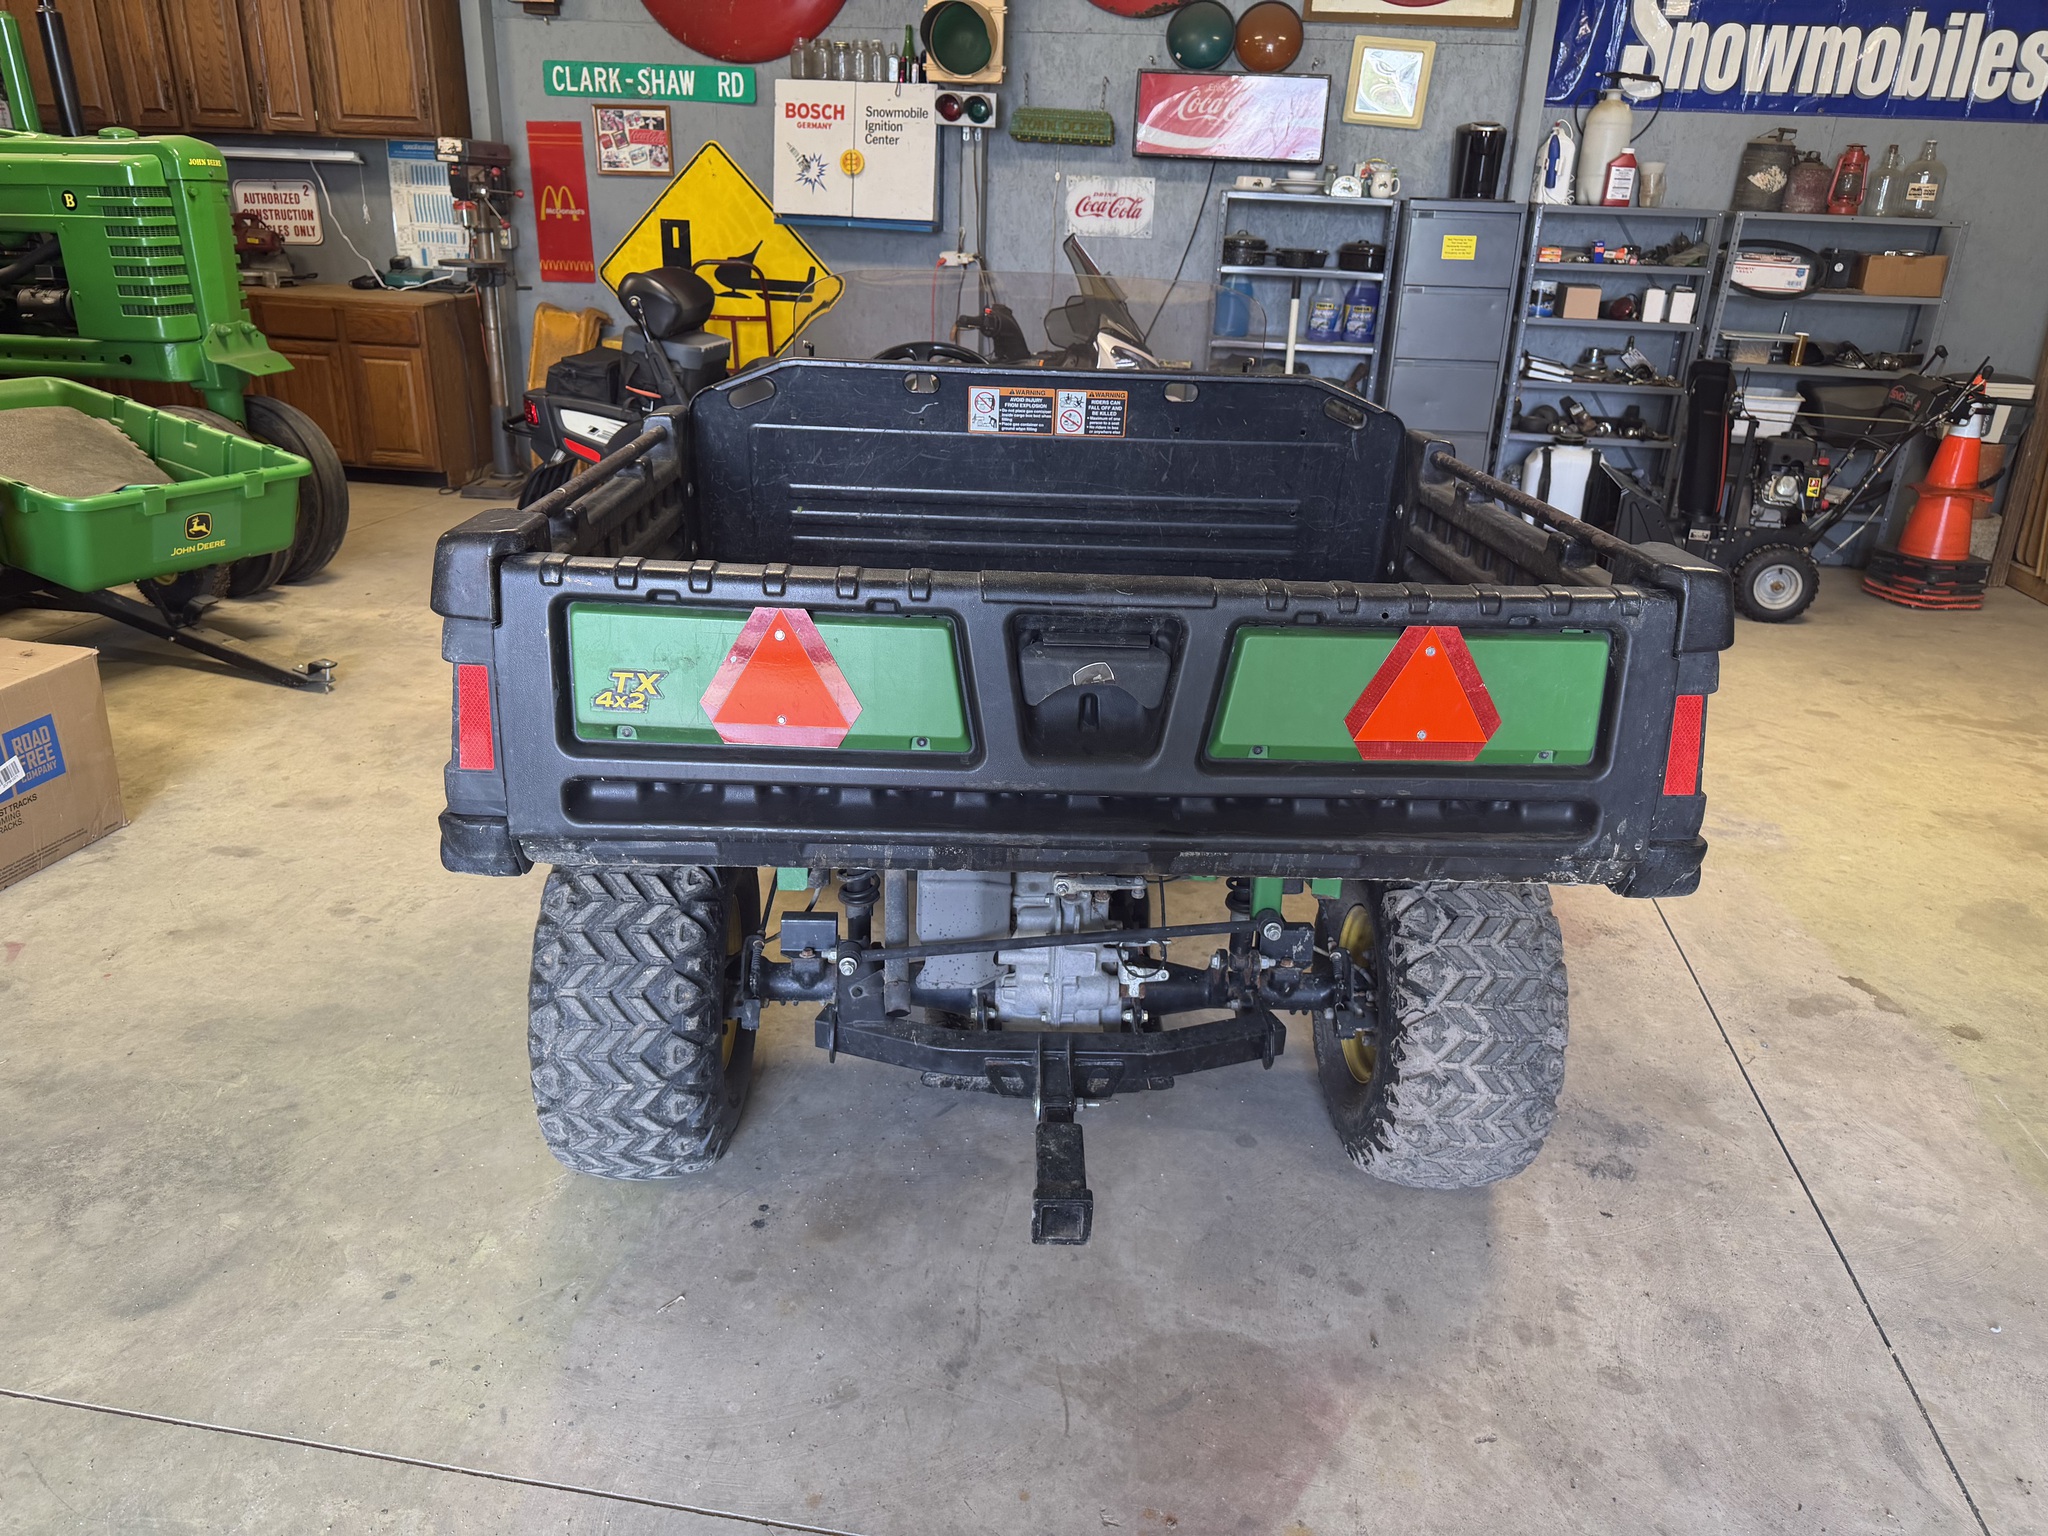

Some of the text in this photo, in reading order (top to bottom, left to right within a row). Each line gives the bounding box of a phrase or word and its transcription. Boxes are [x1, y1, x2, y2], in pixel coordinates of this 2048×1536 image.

[1619, 0, 2048, 98] Snowmobiles
[552, 66, 745, 98] CLARK-SHAW RD
[785, 102, 845, 121] BOSCH
[865, 105, 929, 120] Snowmobile
[797, 121, 833, 130] GERMANY
[864, 120, 903, 134] Ignition
[864, 134, 900, 146] Center
[188, 158, 222, 167] JOHN DEERE
[243, 192, 301, 205] AUTHORIZED
[302, 184, 309, 197] 2
[63, 193, 76, 208] B
[546, 207, 585, 216] McDonald's
[293, 225, 316, 238] ONLY
[170, 540, 226, 557] JOHN DEERE
[611, 672, 661, 695] TX
[595, 691, 646, 709] 4x2
[11, 725, 51, 757] ROAD
[18, 742, 56, 771] FREE
[21, 760, 57, 783] COMPANY
[8, 793, 38, 812] TRACKS
